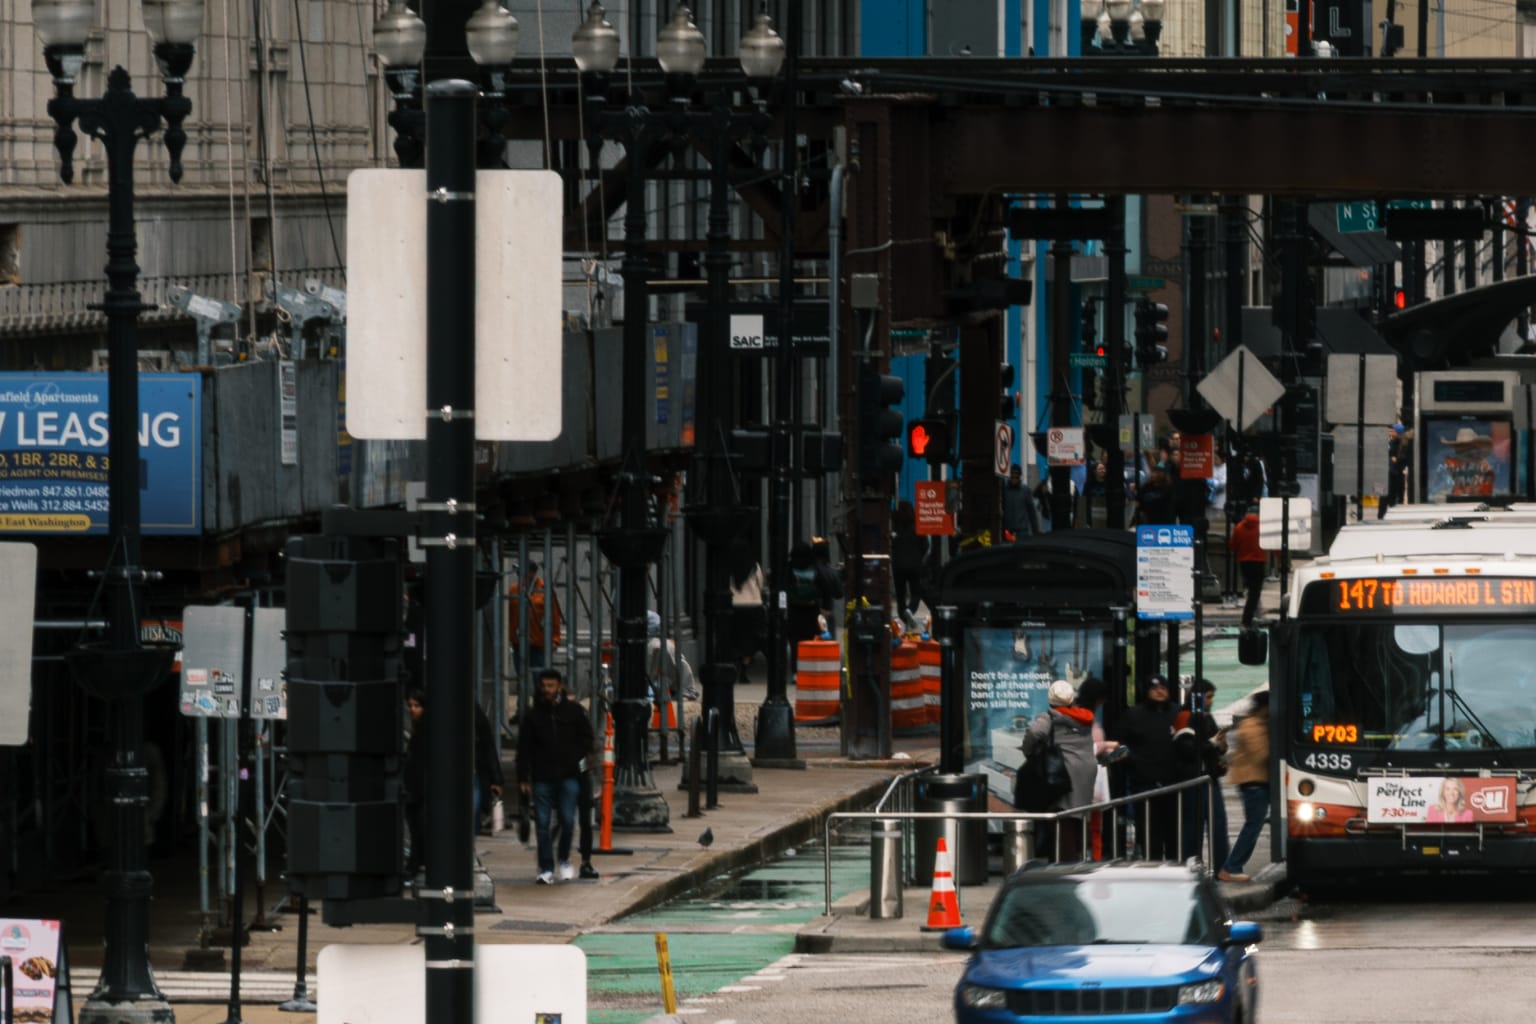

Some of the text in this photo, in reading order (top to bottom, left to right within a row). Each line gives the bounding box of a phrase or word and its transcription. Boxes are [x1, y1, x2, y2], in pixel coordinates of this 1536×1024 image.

[732, 336, 761, 346] SAIC
[33, 391, 99, 405] Apartments
[14, 453, 45, 467] 1BR,
[49, 452, 82, 468] 2BR,
[86, 455, 97, 469] &
[10, 469, 42, 477] AGENT
[43, 470, 59, 478] ON
[11, 499, 39, 511] Wells
[28, 516, 86, 530] Washington
[1339, 579, 1536, 609] 147 TO HOWARD L STN
[971, 671, 996, 680] Don't
[997, 672, 1008, 680] be
[971, 681, 994, 691] Keep
[995, 681, 1007, 689] all
[1008, 681, 1034, 690] those
[971, 691, 1029, 700] band t-shirts
[971, 700, 1031, 711] you still love.
[1313, 724, 1358, 743] P703
[1305, 753, 1352, 770] 4335
[1376, 786, 1423, 799] Perfect
[1401, 797, 1426, 807] Line
